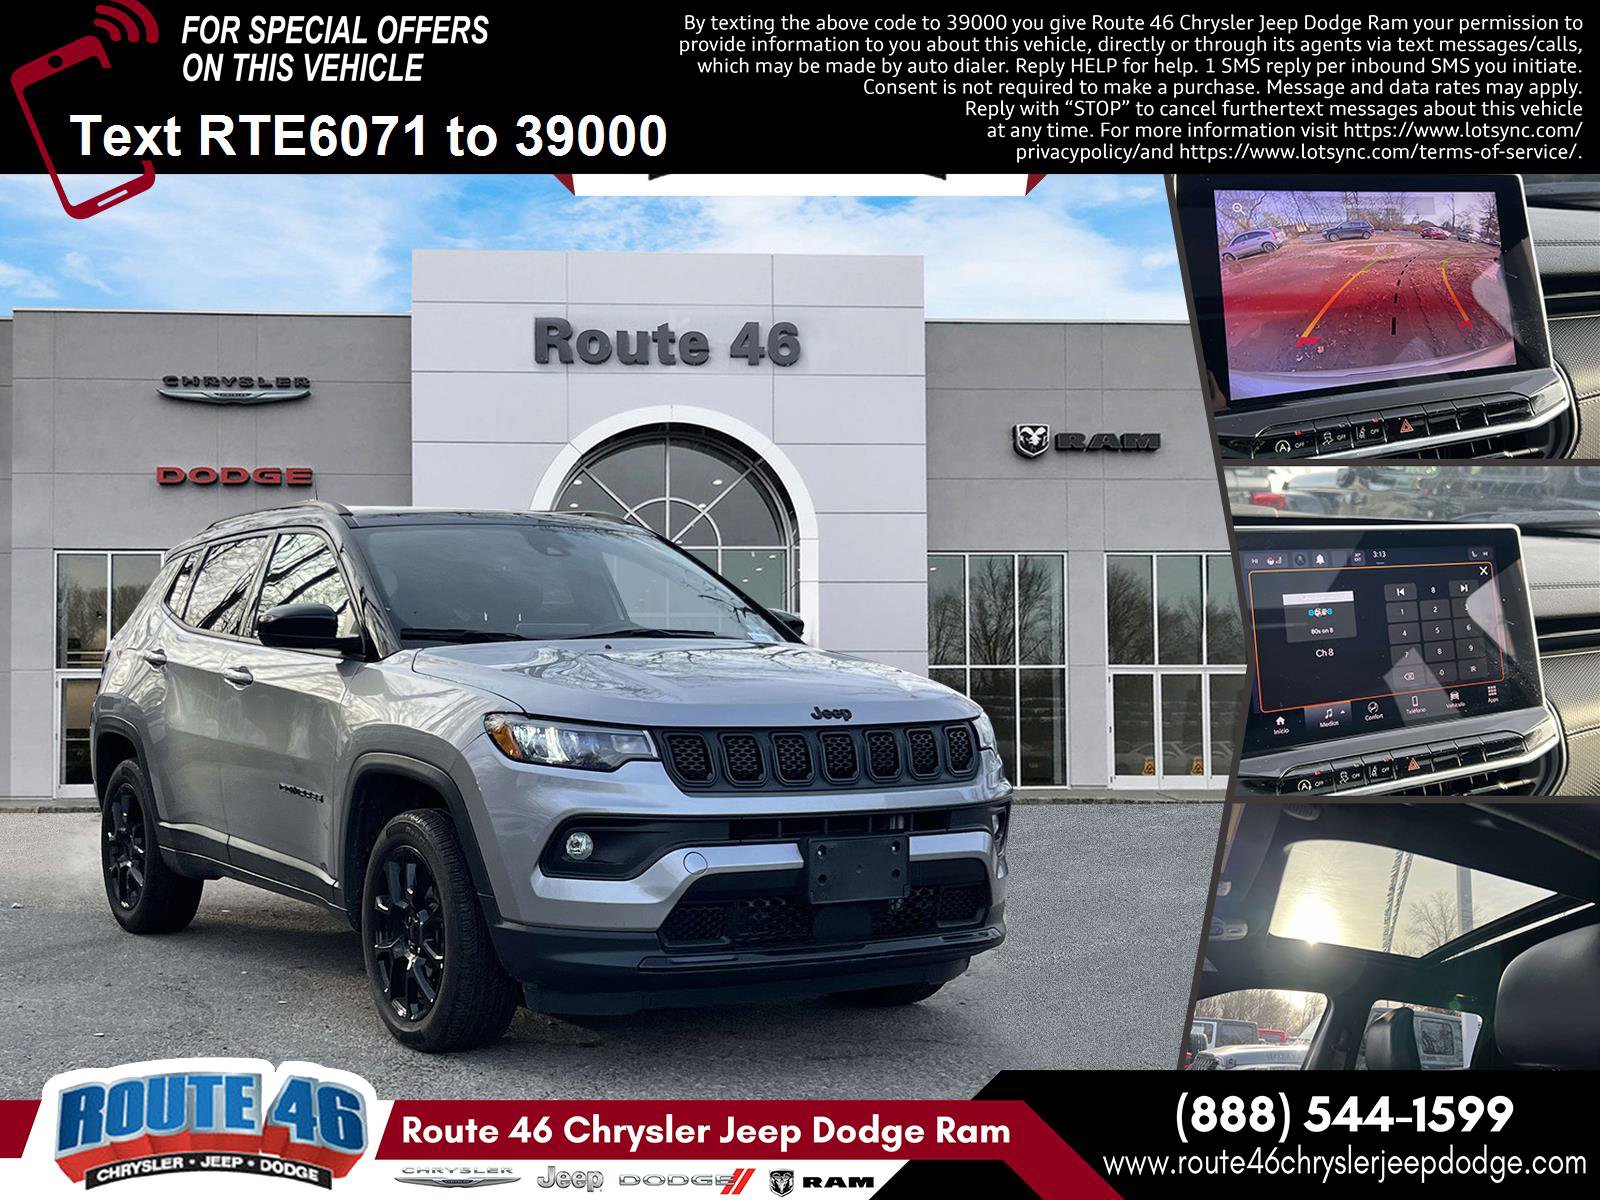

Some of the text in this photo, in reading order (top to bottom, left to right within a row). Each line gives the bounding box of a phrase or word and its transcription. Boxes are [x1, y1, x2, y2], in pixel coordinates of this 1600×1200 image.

[534, 317, 803, 368] Route 46
[162, 375, 311, 387] CHRYSLER
[1055, 433, 1161, 452] RAM
[156, 466, 315, 486] DODGE
[1372, 550, 1387, 559] 3:13
[1315, 648, 1327, 657] Ch
[810, 706, 853, 722] Jeep
